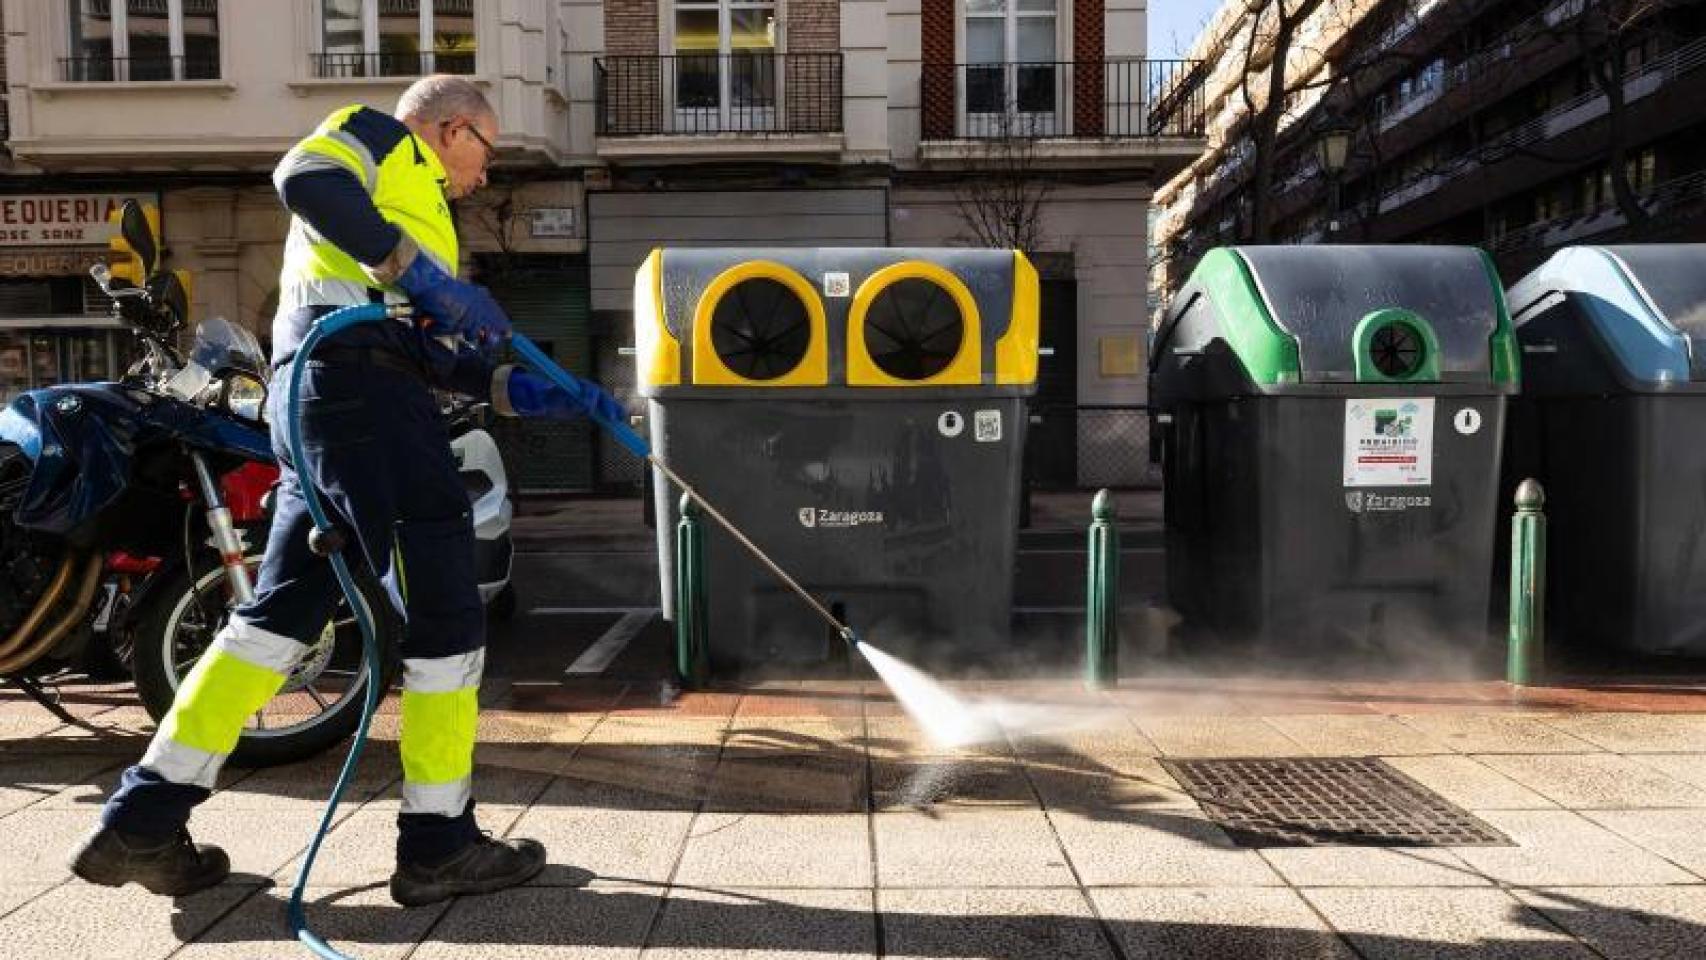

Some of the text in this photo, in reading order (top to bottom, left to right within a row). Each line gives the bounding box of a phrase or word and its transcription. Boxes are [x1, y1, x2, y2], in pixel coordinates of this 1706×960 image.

[41, 229, 84, 240] SANZ
[1366, 492, 1431, 509] Zaragoza
[819, 509, 884, 525] Zaragoza
